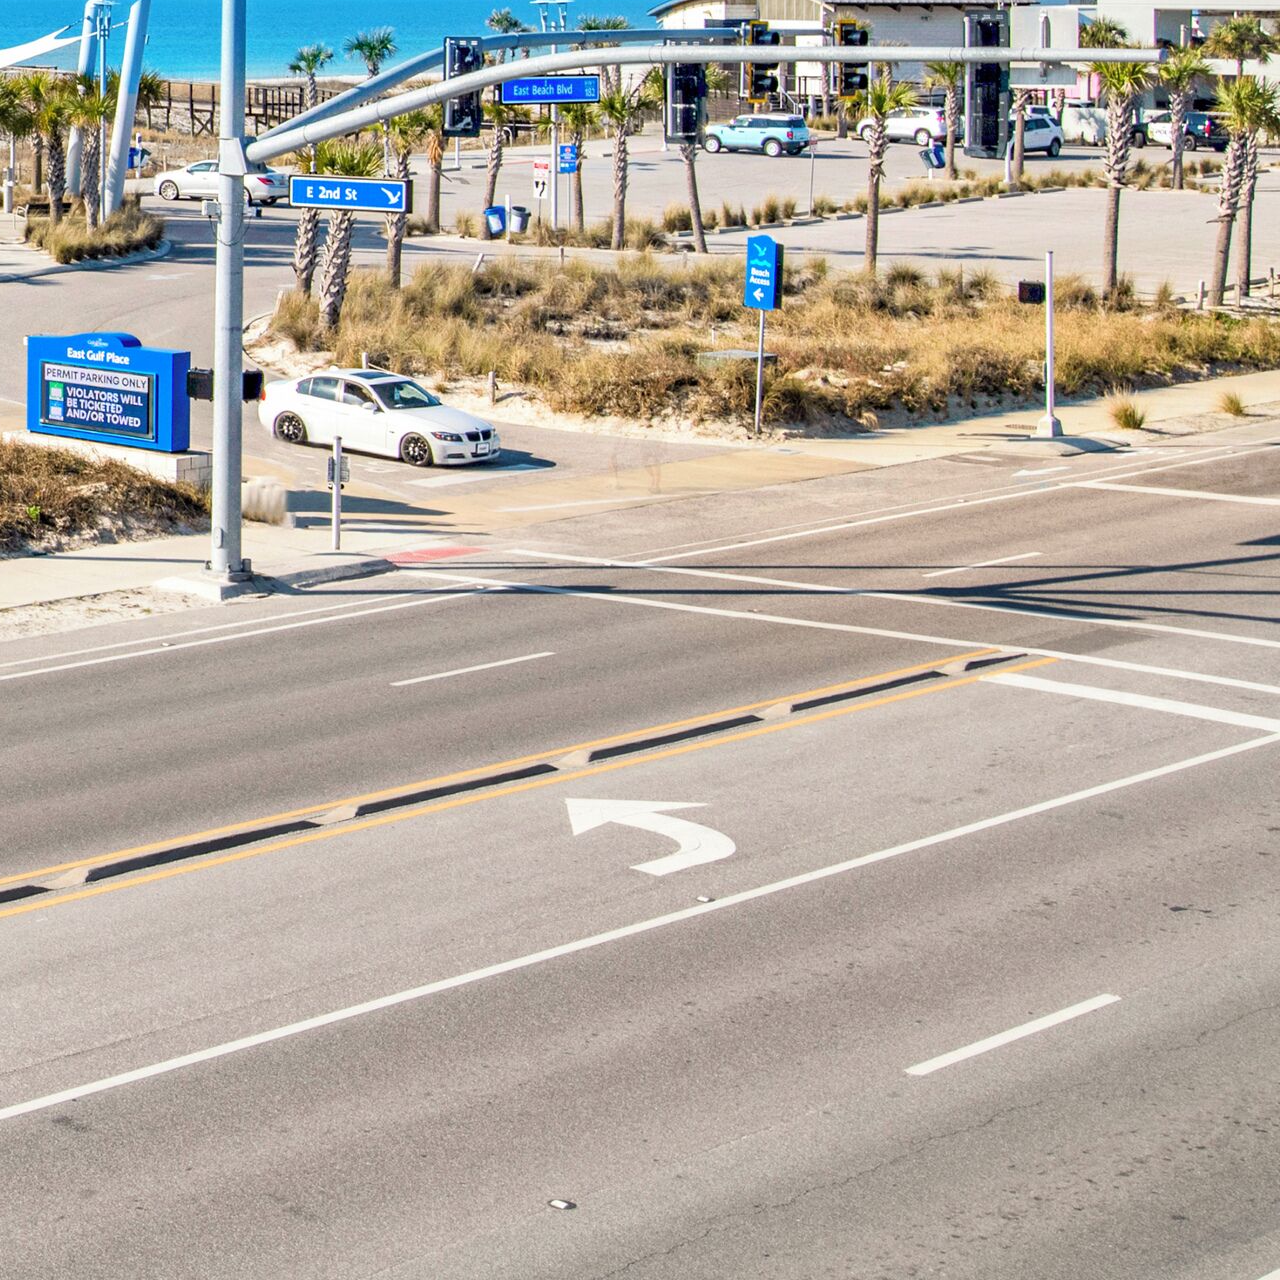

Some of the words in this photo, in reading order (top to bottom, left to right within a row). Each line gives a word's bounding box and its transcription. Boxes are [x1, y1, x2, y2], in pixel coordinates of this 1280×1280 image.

[513, 85, 529, 96] East
[532, 84, 554, 96] Beach
[557, 83, 573, 95] Blvd
[585, 87, 595, 97] 182
[306, 186, 314, 198] E
[318, 185, 340, 200] 2nd
[345, 188, 358, 201] St
[749, 275, 770, 286] Access
[751, 267, 770, 278] Beach
[66, 347, 85, 360] East
[86, 349, 105, 362] Gulf
[106, 352, 130, 365] Place
[46, 367, 78, 380] PERMIT
[80, 372, 120, 386] PARKING
[122, 377, 147, 389] ONLY
[66, 386, 119, 403] VIOLATORS
[120, 394, 144, 406] WILL
[66, 398, 78, 408] BE
[79, 399, 123, 414] TICKETED
[66, 408, 105, 422] AND/OR
[105, 413, 141, 427] TOWED
